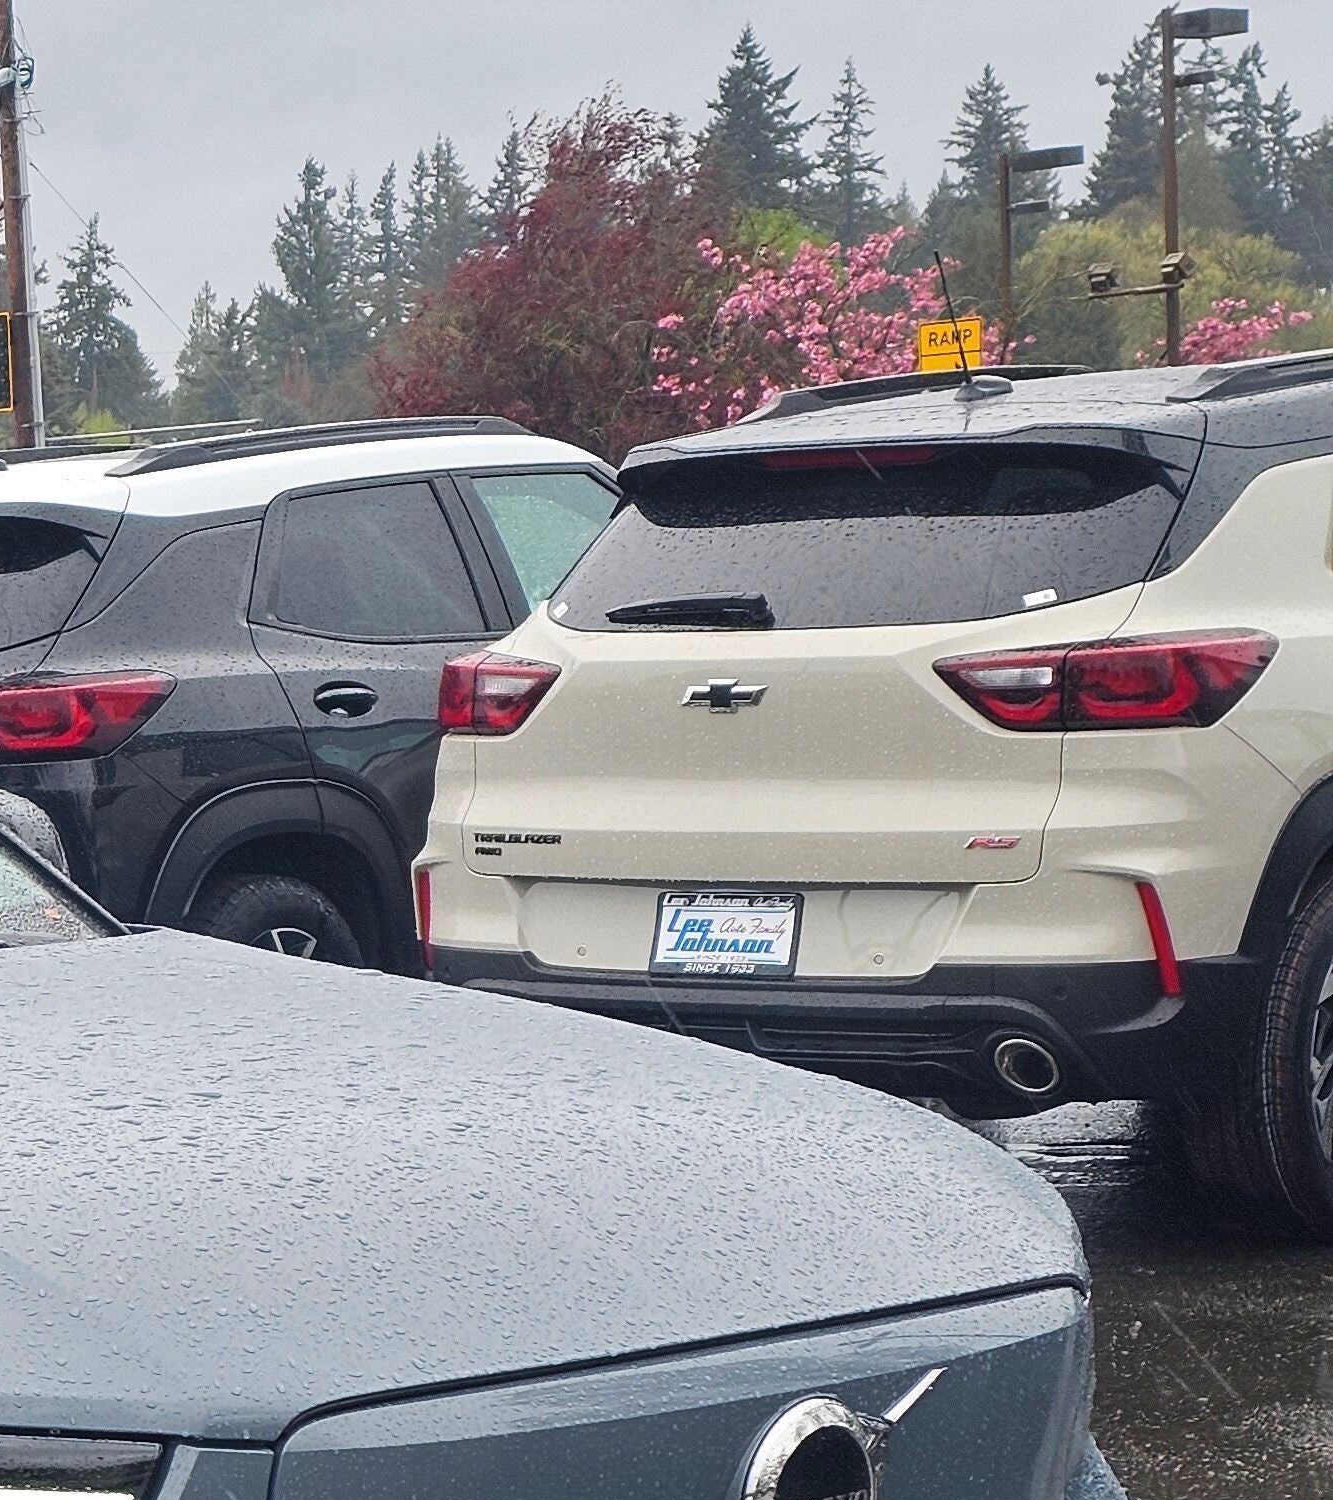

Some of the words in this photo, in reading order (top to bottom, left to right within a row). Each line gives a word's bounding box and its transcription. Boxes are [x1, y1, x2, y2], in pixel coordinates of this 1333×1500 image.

[928, 329, 972, 347] RAMP
[473, 832, 562, 845] TRAILBLAZER
[964, 836, 1022, 849] RS
[667, 908, 715, 933] Lee
[665, 930, 776, 954] Johnson
[683, 962, 722, 973] SINCE
